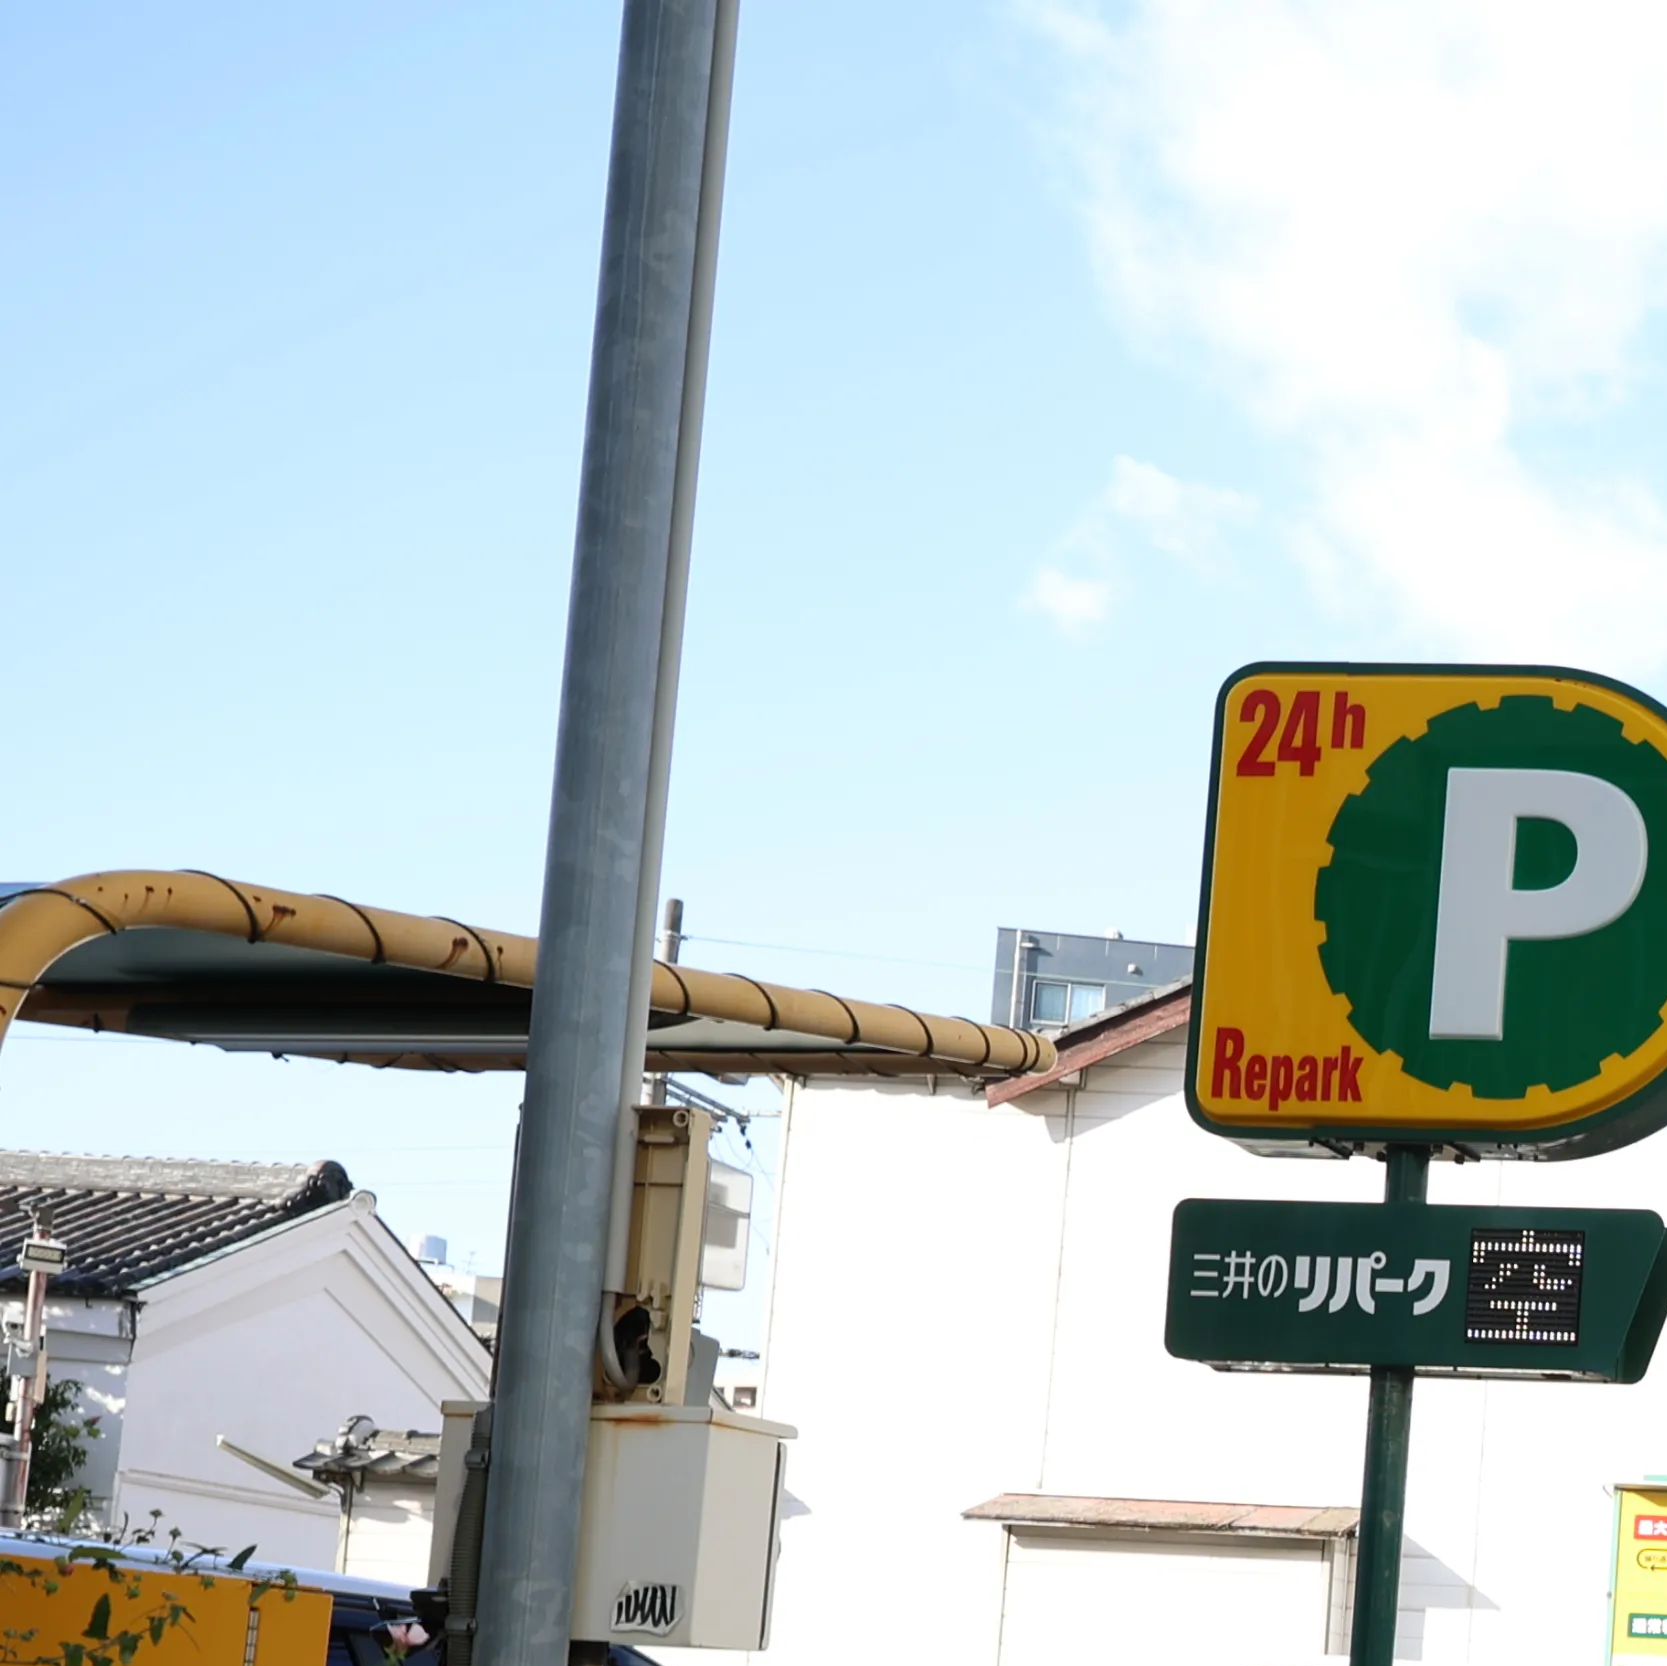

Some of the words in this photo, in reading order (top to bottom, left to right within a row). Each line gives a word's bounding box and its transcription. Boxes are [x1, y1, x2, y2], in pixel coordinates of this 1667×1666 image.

[1236, 688, 1367, 777] 24h
[1429, 766, 1649, 1041] P
[1211, 1026, 1364, 1111] Repark
[1189, 1249, 1450, 1316] 三井のリパーク
